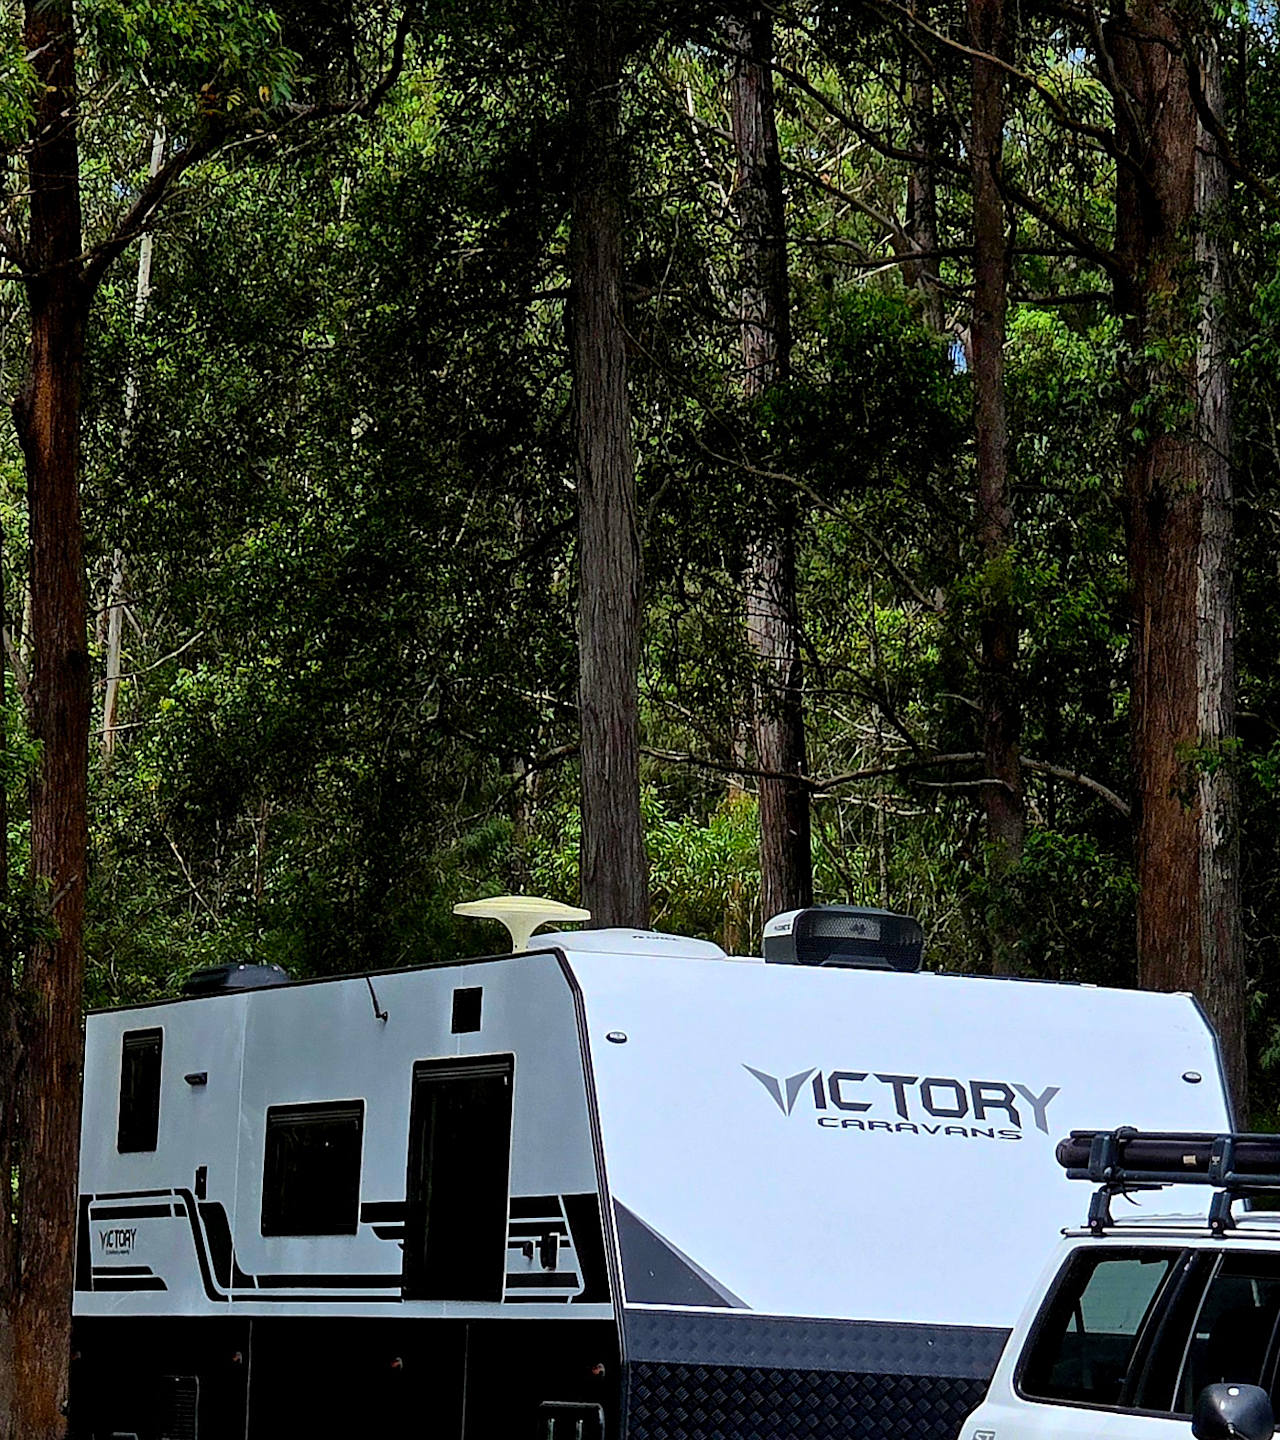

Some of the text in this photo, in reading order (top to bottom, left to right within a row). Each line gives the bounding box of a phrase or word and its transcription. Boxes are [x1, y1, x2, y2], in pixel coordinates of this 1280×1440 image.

[741, 1063, 1061, 1136] VICTORY
[817, 1117, 1023, 1140] CARAVANS
[99, 1228, 137, 1250] VICTORY
